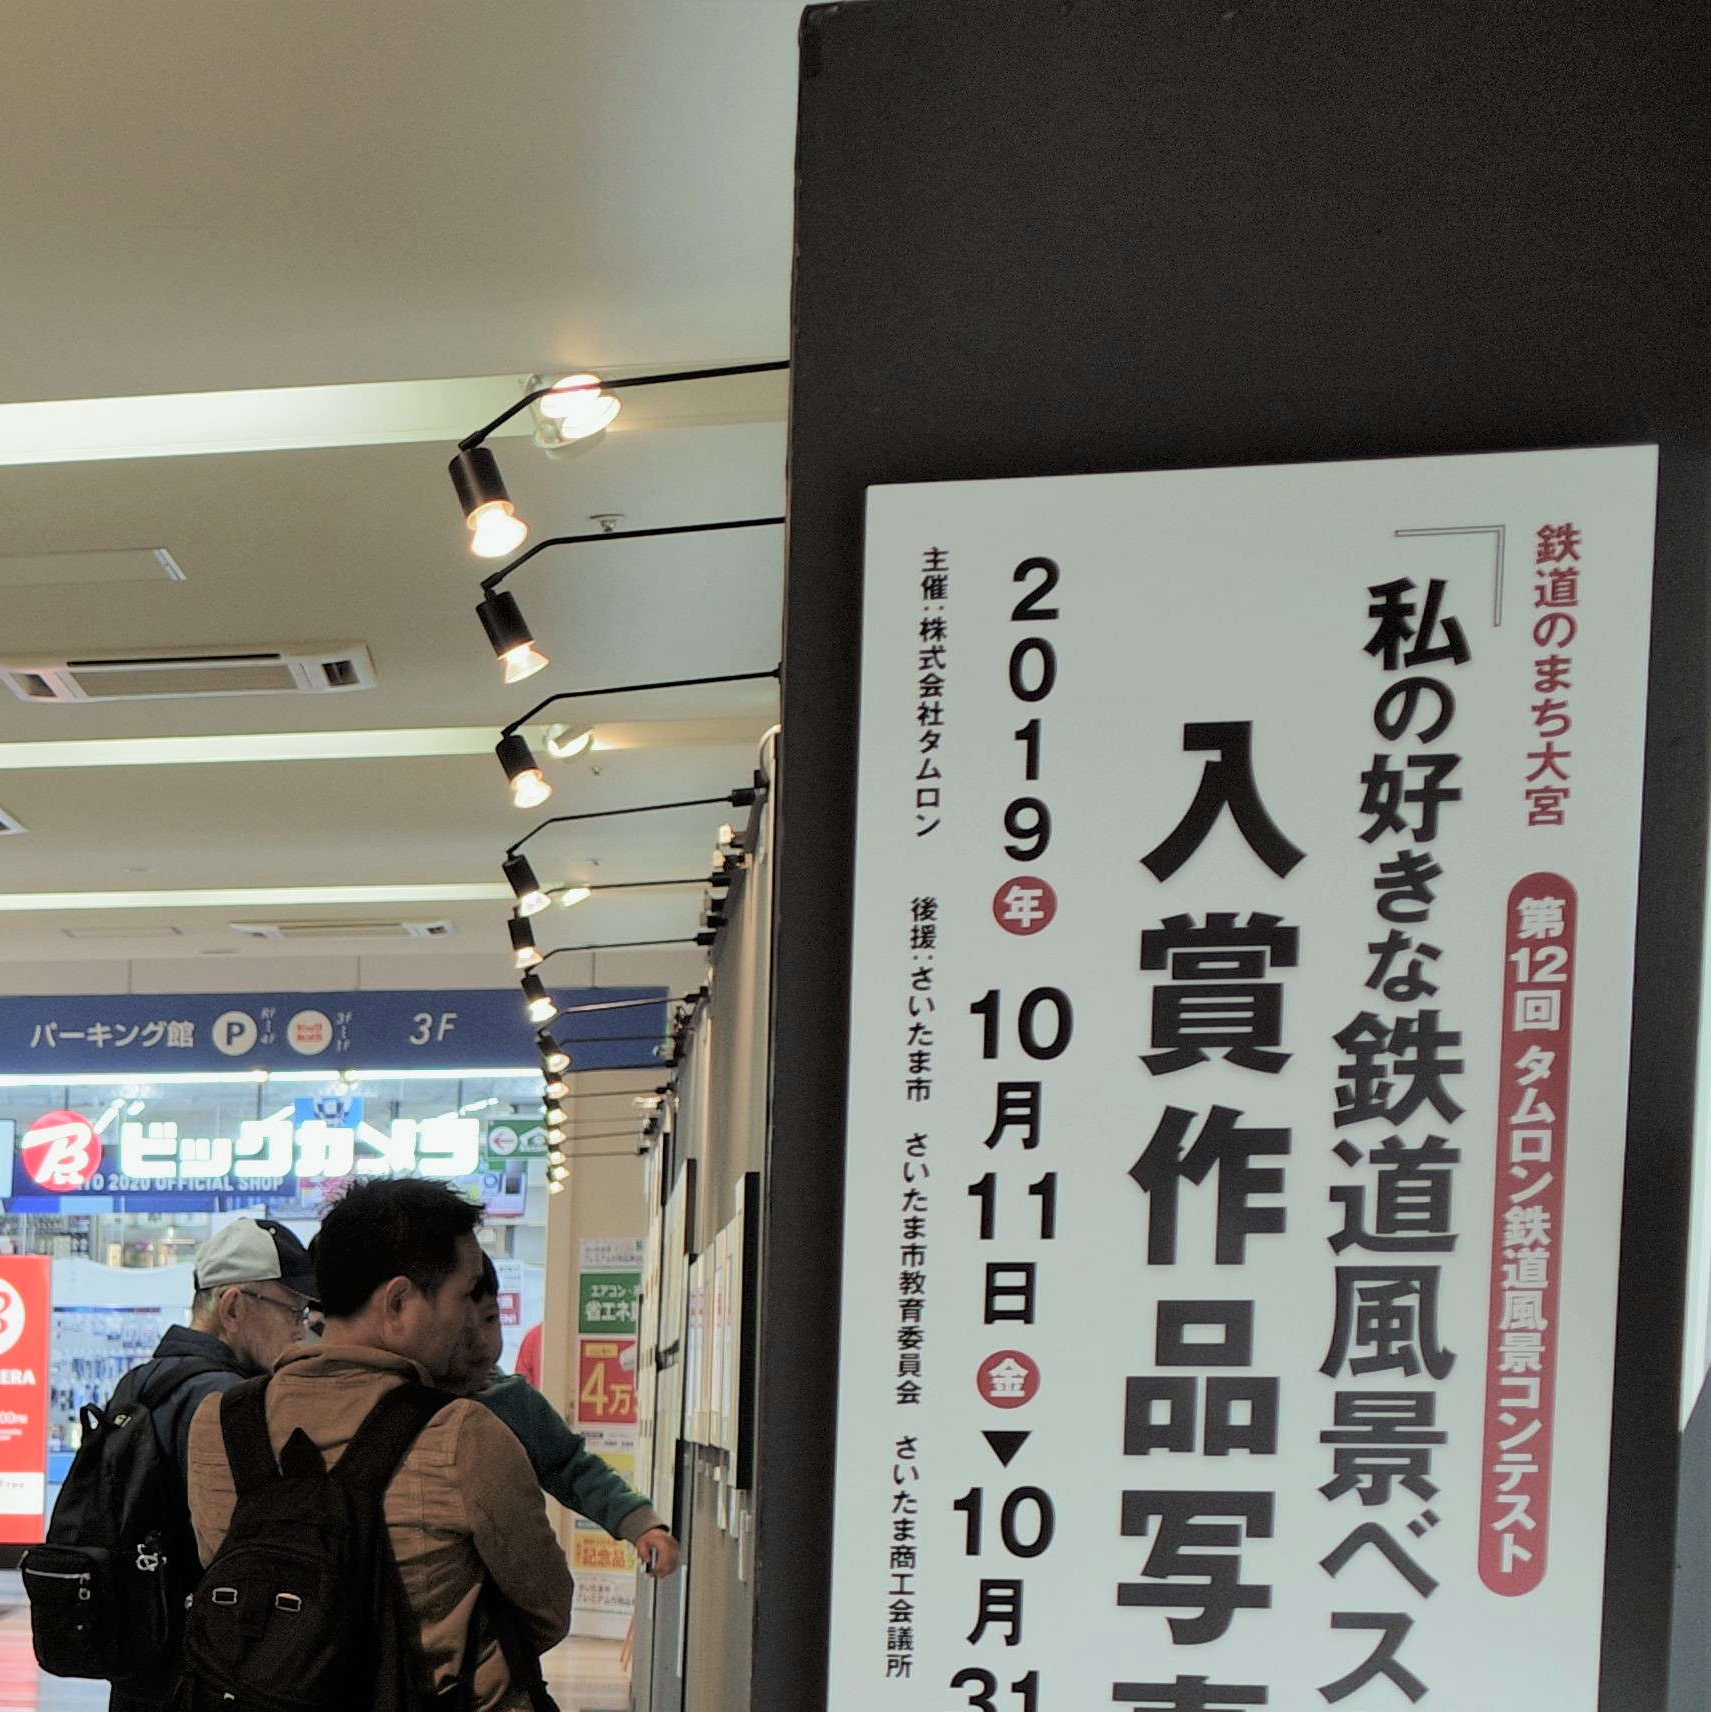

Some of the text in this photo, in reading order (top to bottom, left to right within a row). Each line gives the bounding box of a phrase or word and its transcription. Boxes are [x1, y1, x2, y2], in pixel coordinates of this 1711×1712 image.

[916, 547, 948, 837] 主催：株式会社タムロン
[1525, 523, 1581, 826] 鉄道のまち大宮
[31, 1020, 195, 1047] パーキング館
[410, 1013, 457, 1044] 3F
[108, 1174, 152, 1191] 2020
[155, 1176, 235, 1191] OFFICIAL
[239, 1175, 285, 1191] SHOP
[585, 1299, 636, 1322] 省エネ
[886, 897, 938, 1677] 後援：さいたま市 さいたま市教育委員会 さいたま商工会議所
[1490, 898, 1569, 1575] 第12回 タムロン鉄道風景コンテスト
